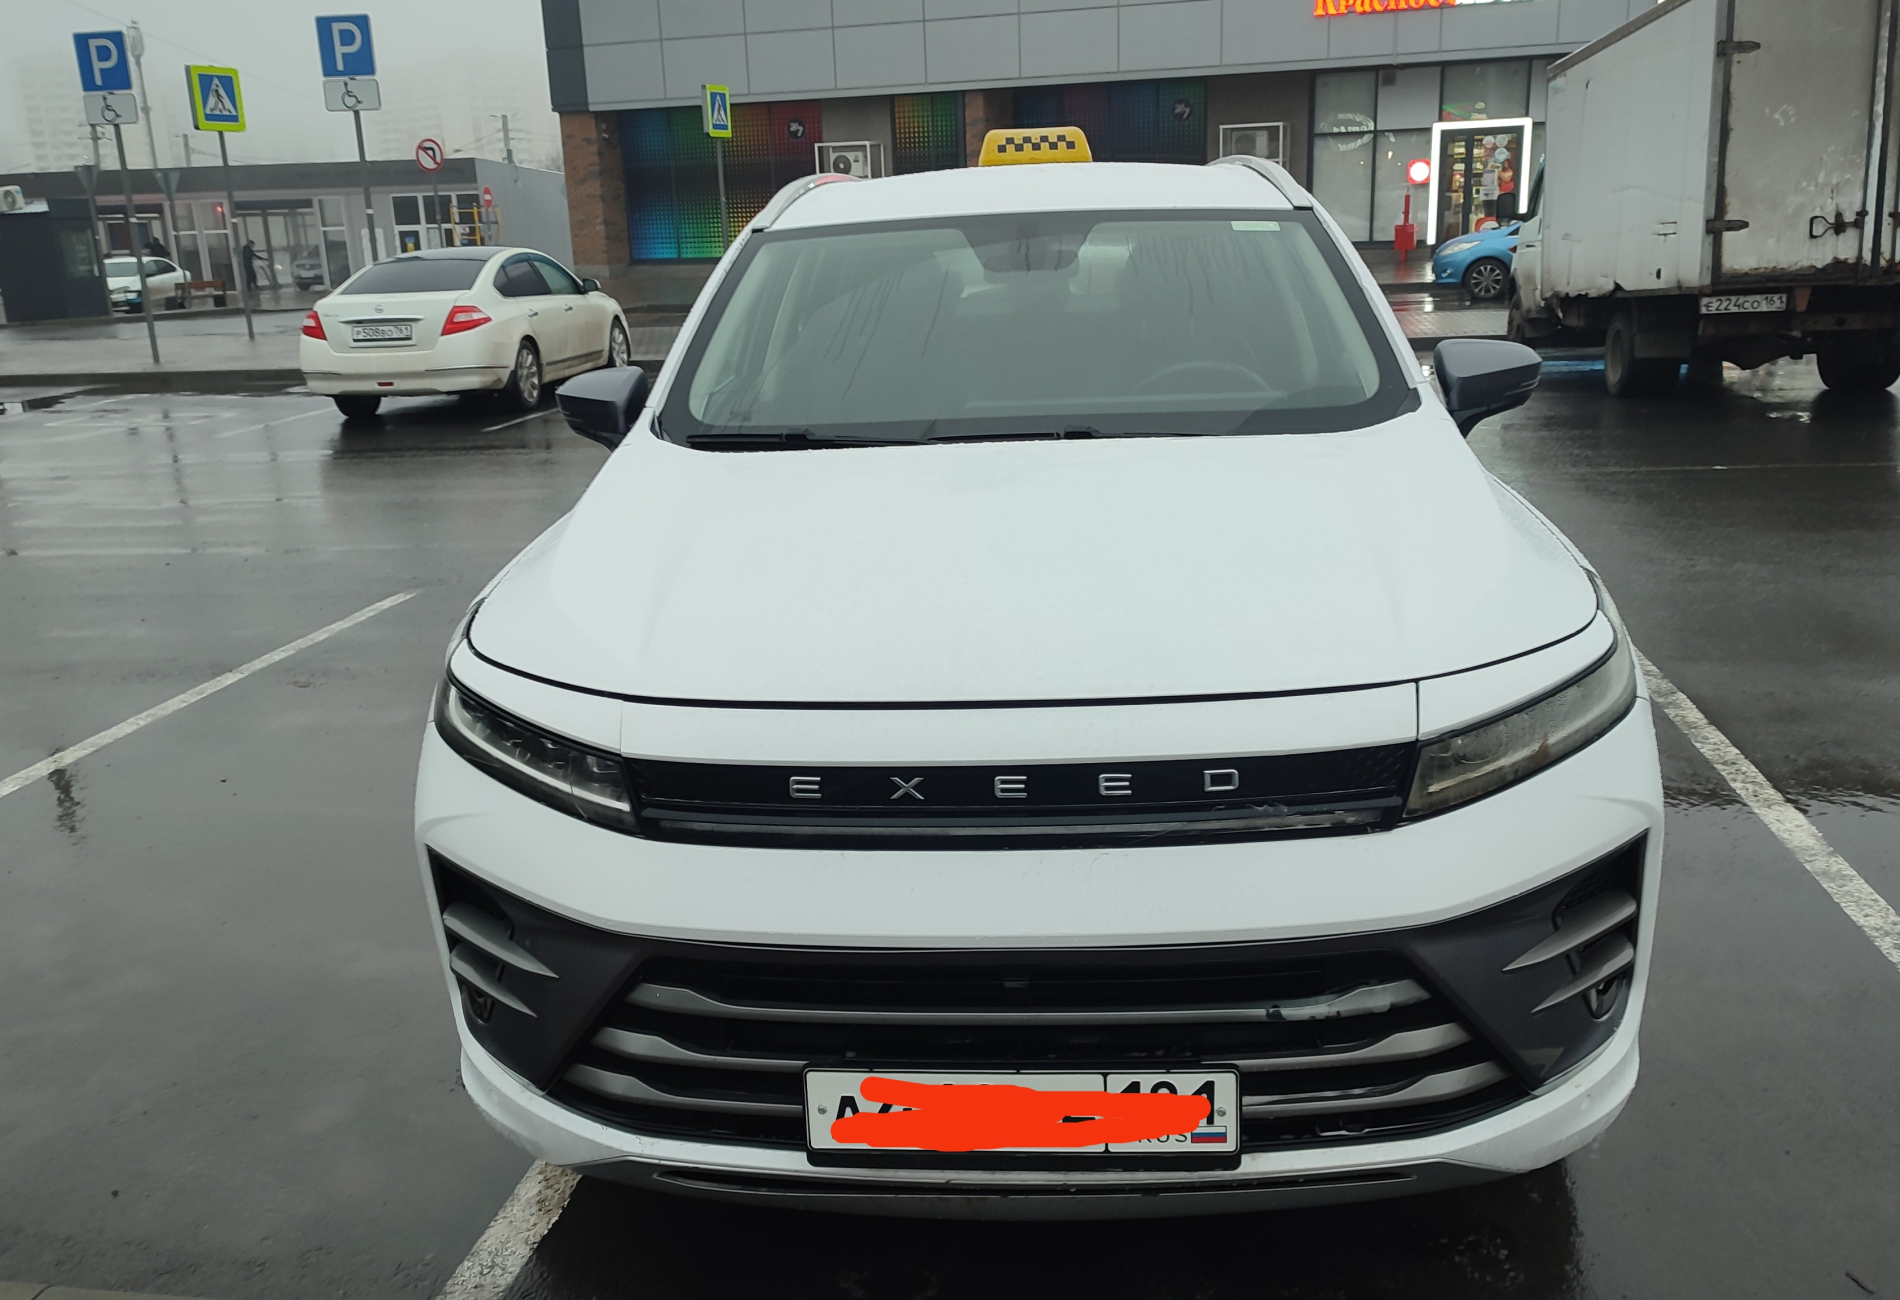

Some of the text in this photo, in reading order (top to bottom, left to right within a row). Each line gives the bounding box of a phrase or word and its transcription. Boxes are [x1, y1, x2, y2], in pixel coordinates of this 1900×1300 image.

[88, 38, 118, 86] P
[331, 22, 362, 71] P
[789, 768, 1240, 800] EXEED
